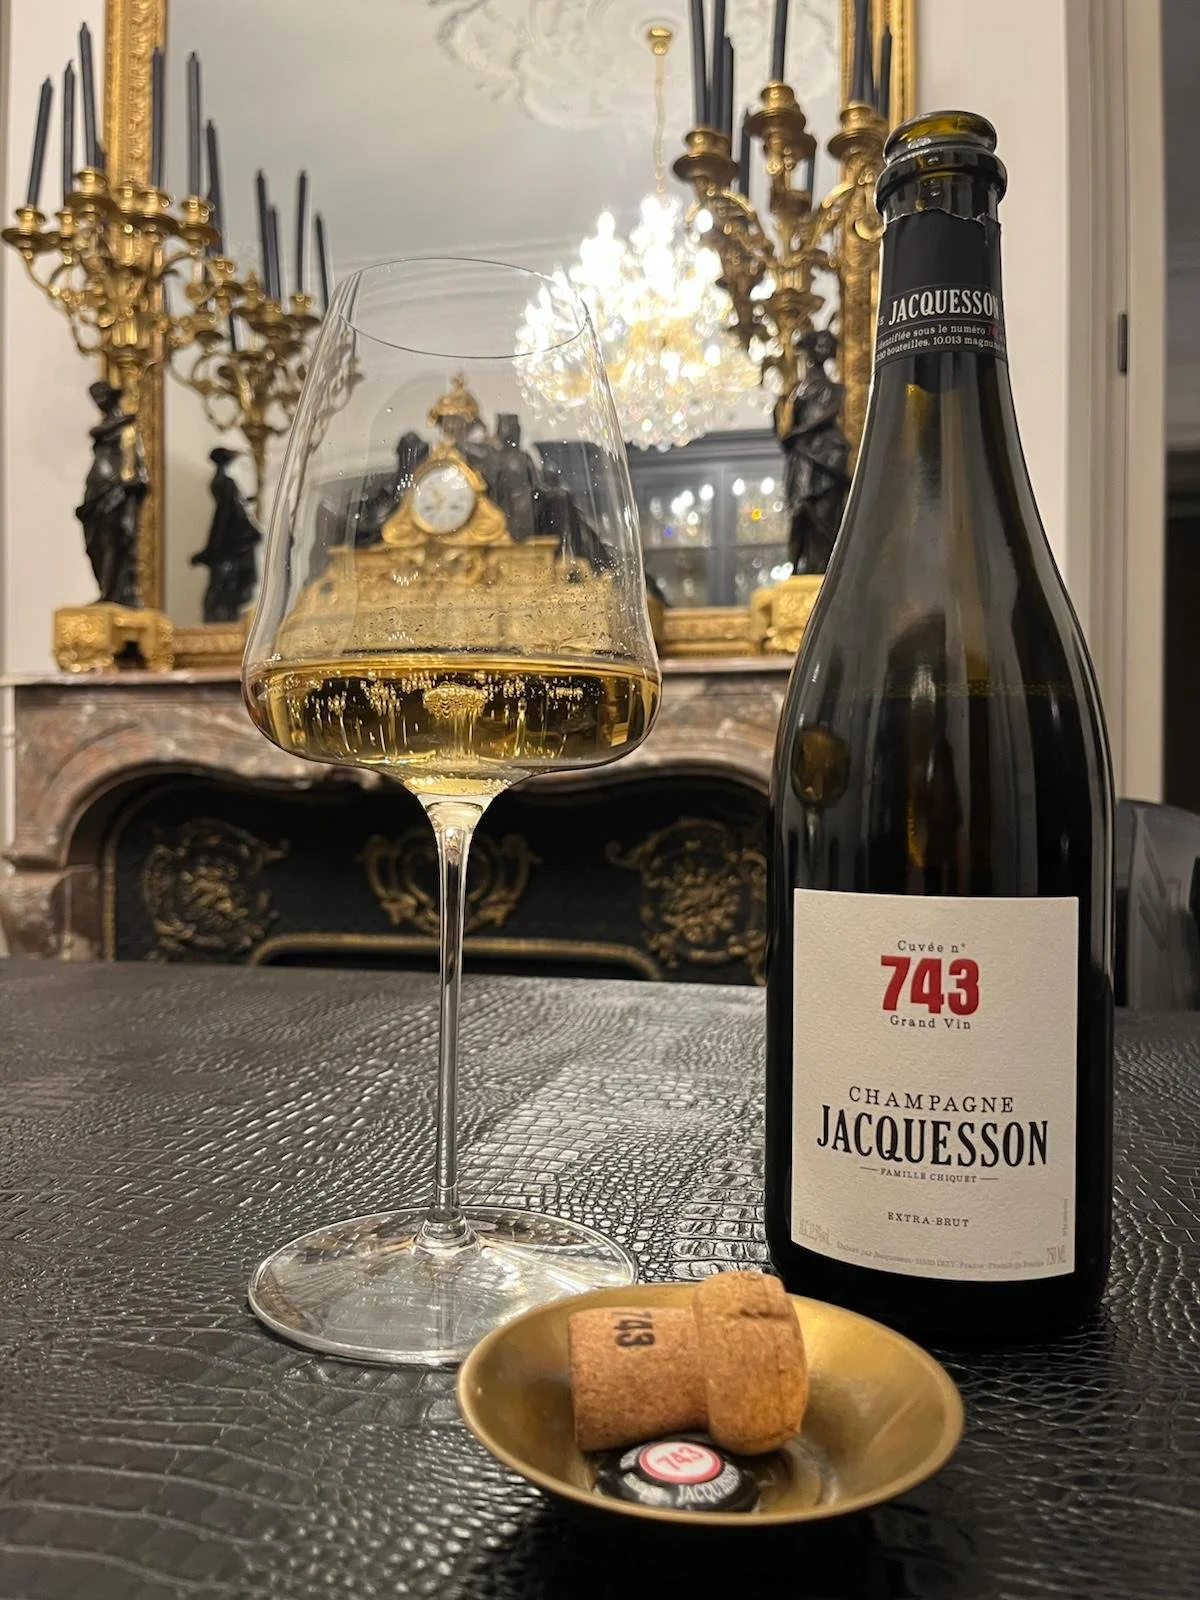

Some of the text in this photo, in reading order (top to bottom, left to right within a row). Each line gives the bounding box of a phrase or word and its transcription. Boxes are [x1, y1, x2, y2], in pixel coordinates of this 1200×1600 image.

[888, 289, 999, 326] JACQUESSON
[913, 326, 936, 338] sous
[938, 324, 948, 334] le
[950, 324, 986, 335] numéro
[897, 940, 944, 952] Cuvée
[881, 955, 980, 1016] 743
[889, 1014, 972, 1030] Grand Vin
[848, 1086, 1014, 1113] CHAMPAGNE
[816, 1104, 1049, 1168] JACQUESSON
[880, 1167, 978, 1183] FAMILLE CHIQUET
[887, 1211, 970, 1228] EXTRA-BRUT
[611, 1311, 656, 1347] 743
[656, 1446, 704, 1471] 743
